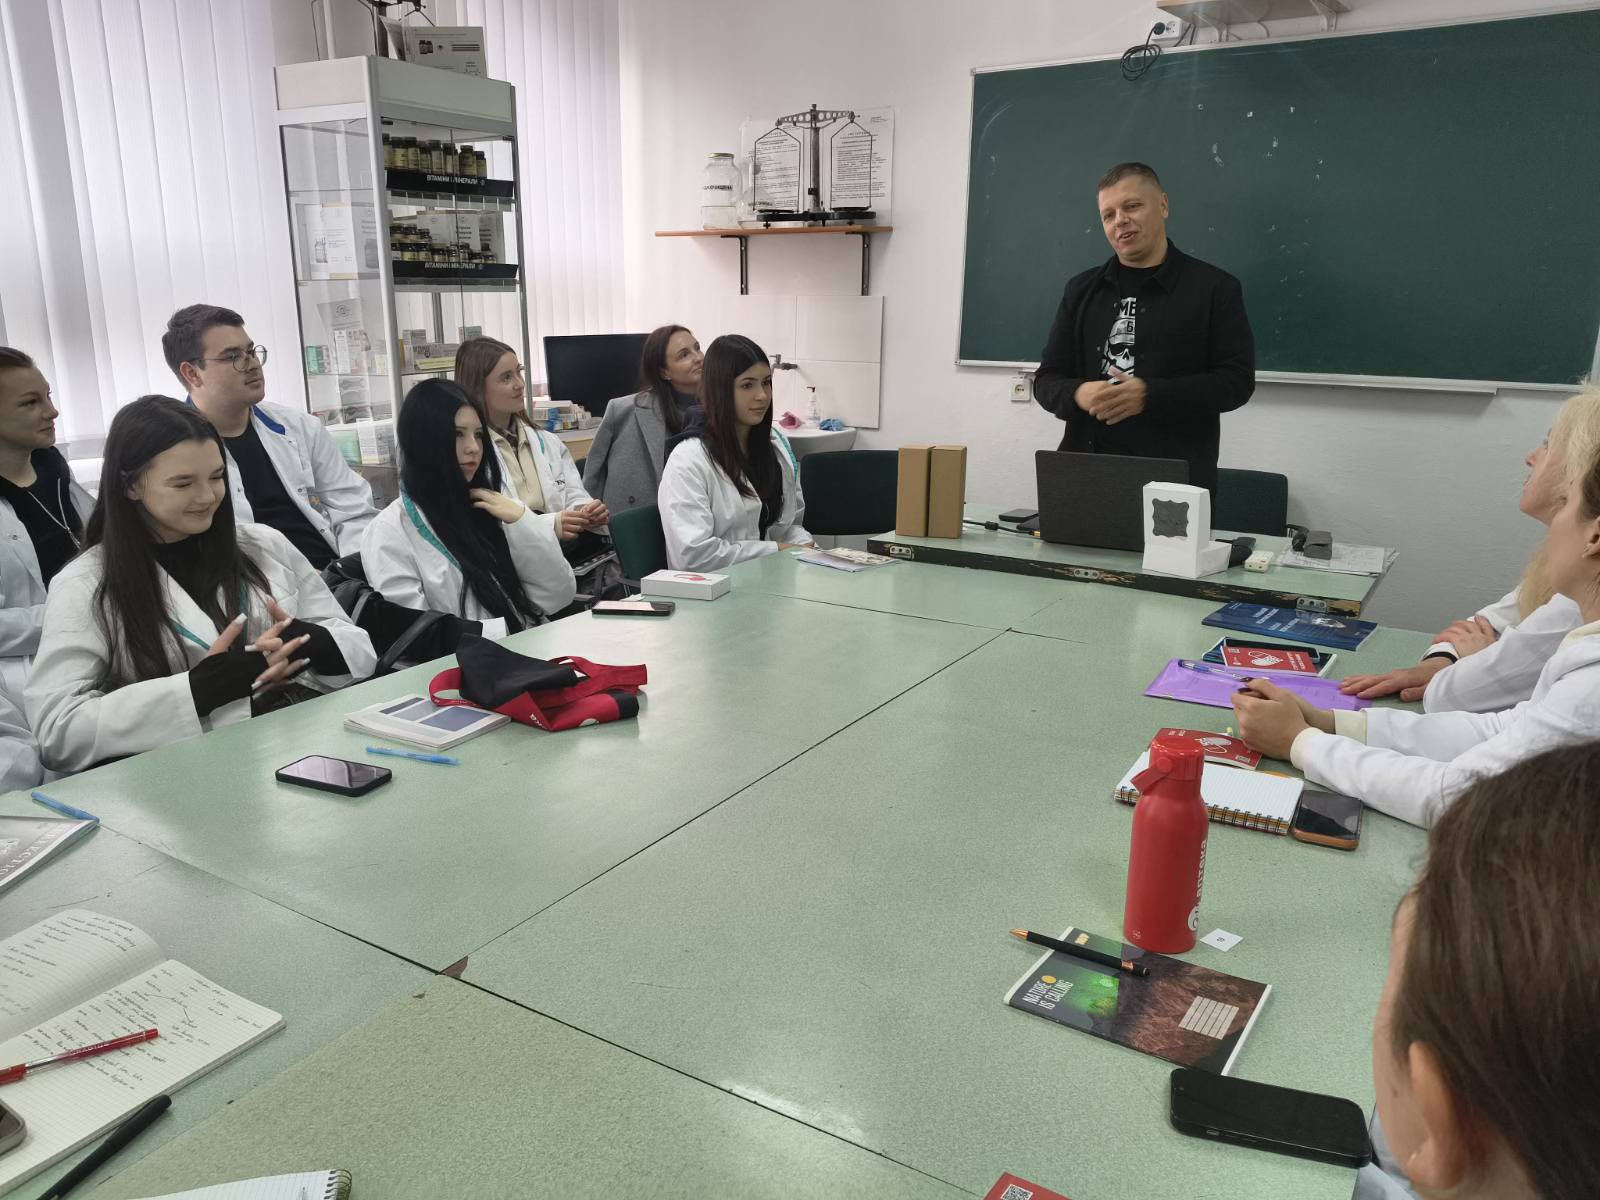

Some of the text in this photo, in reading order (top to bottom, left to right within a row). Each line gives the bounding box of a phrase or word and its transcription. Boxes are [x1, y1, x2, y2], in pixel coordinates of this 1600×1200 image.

[1022, 981, 1051, 1005] NATURE
[1038, 979, 1074, 1010] IS CALLING
